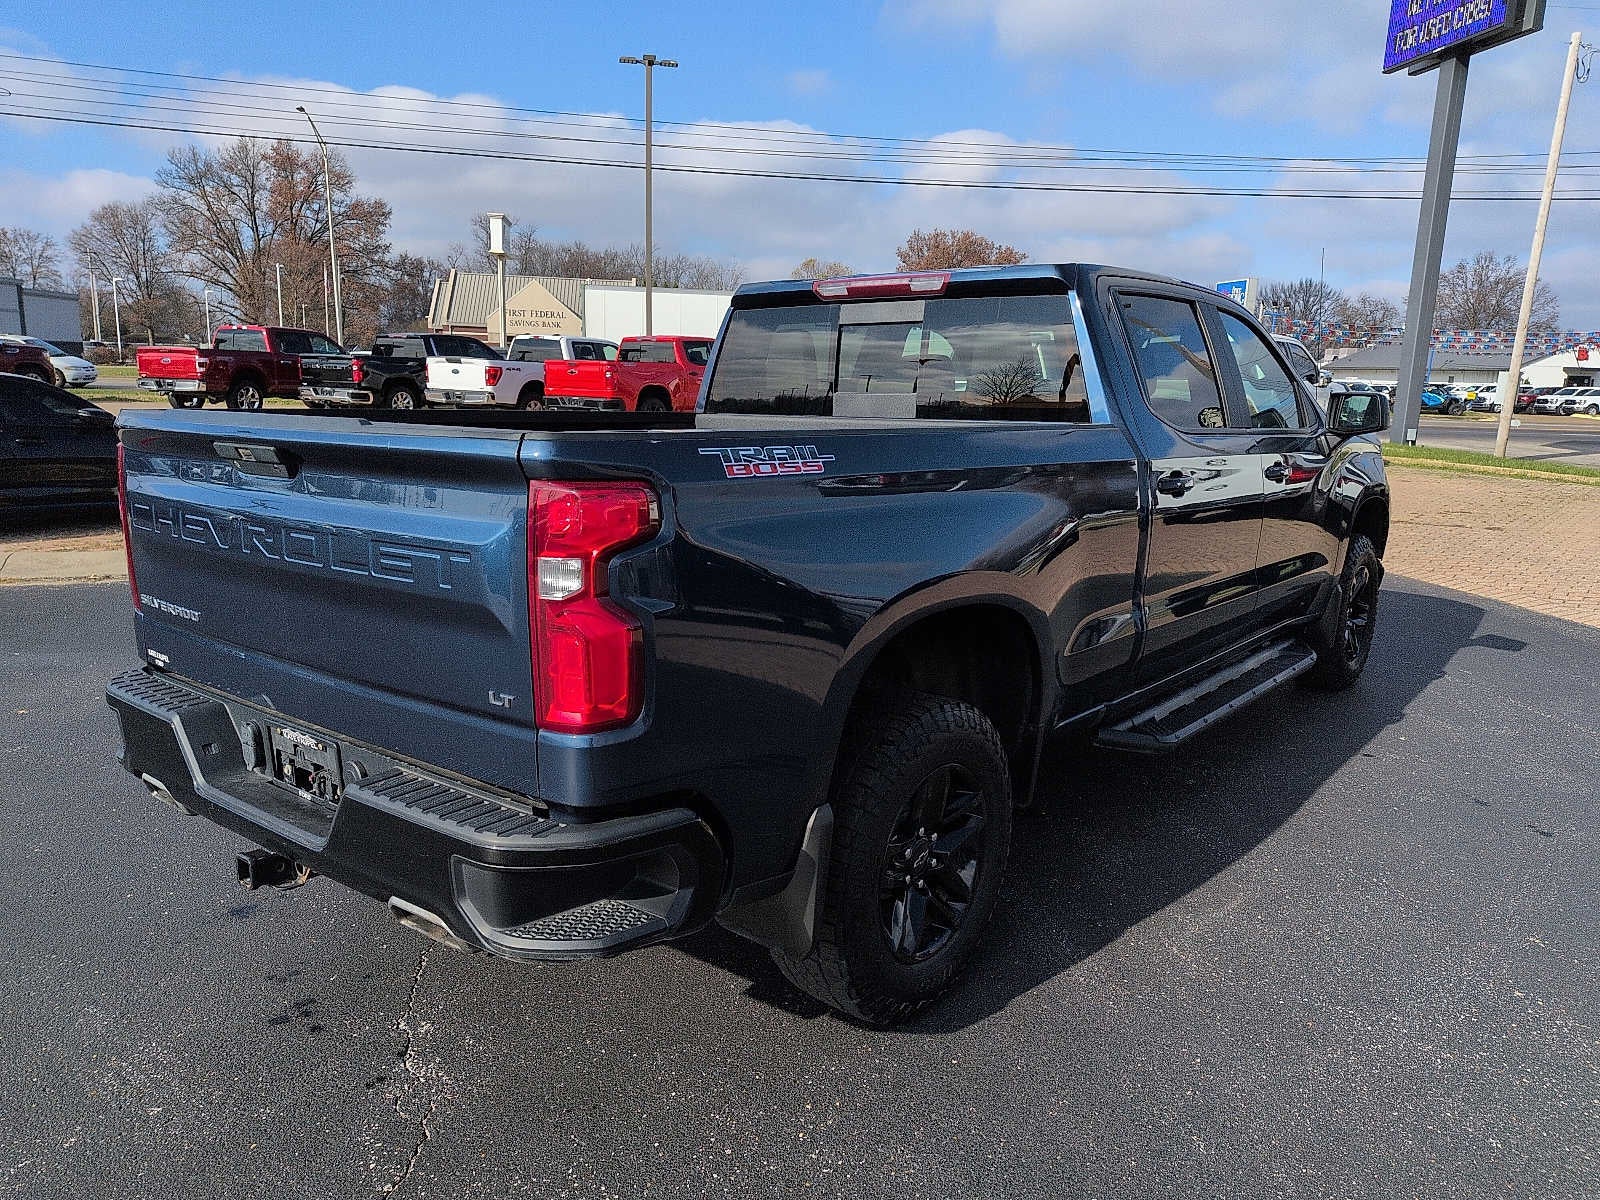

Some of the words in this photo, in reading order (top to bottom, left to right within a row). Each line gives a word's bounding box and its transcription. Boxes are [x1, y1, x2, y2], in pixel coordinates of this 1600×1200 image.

[530, 310, 567, 319] FEDERAL
[509, 320, 540, 328] SAVINGS
[542, 321, 562, 329] BANK
[698, 445, 836, 464] TRAIL
[724, 461, 825, 479] BOSS
[130, 501, 472, 590] CHEVROLET
[488, 690, 516, 708] LT
